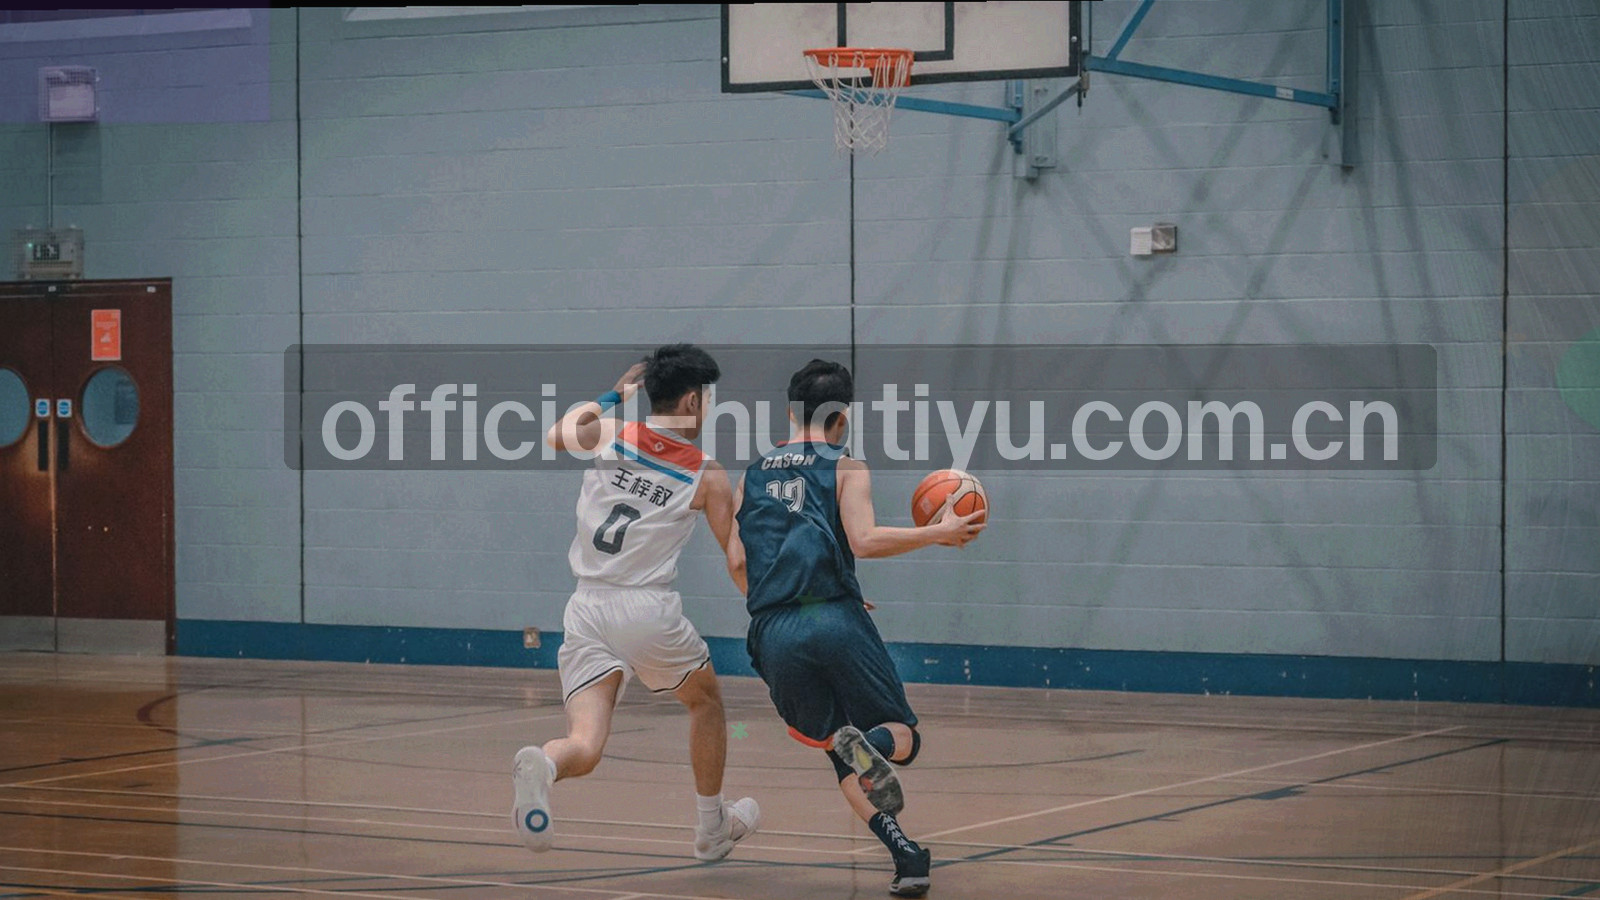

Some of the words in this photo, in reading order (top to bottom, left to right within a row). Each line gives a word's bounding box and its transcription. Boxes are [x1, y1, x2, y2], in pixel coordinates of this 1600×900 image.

[761, 453, 817, 470] CASON
[611, 467, 674, 507] 王梓叙
[593, 503, 641, 555] 0
